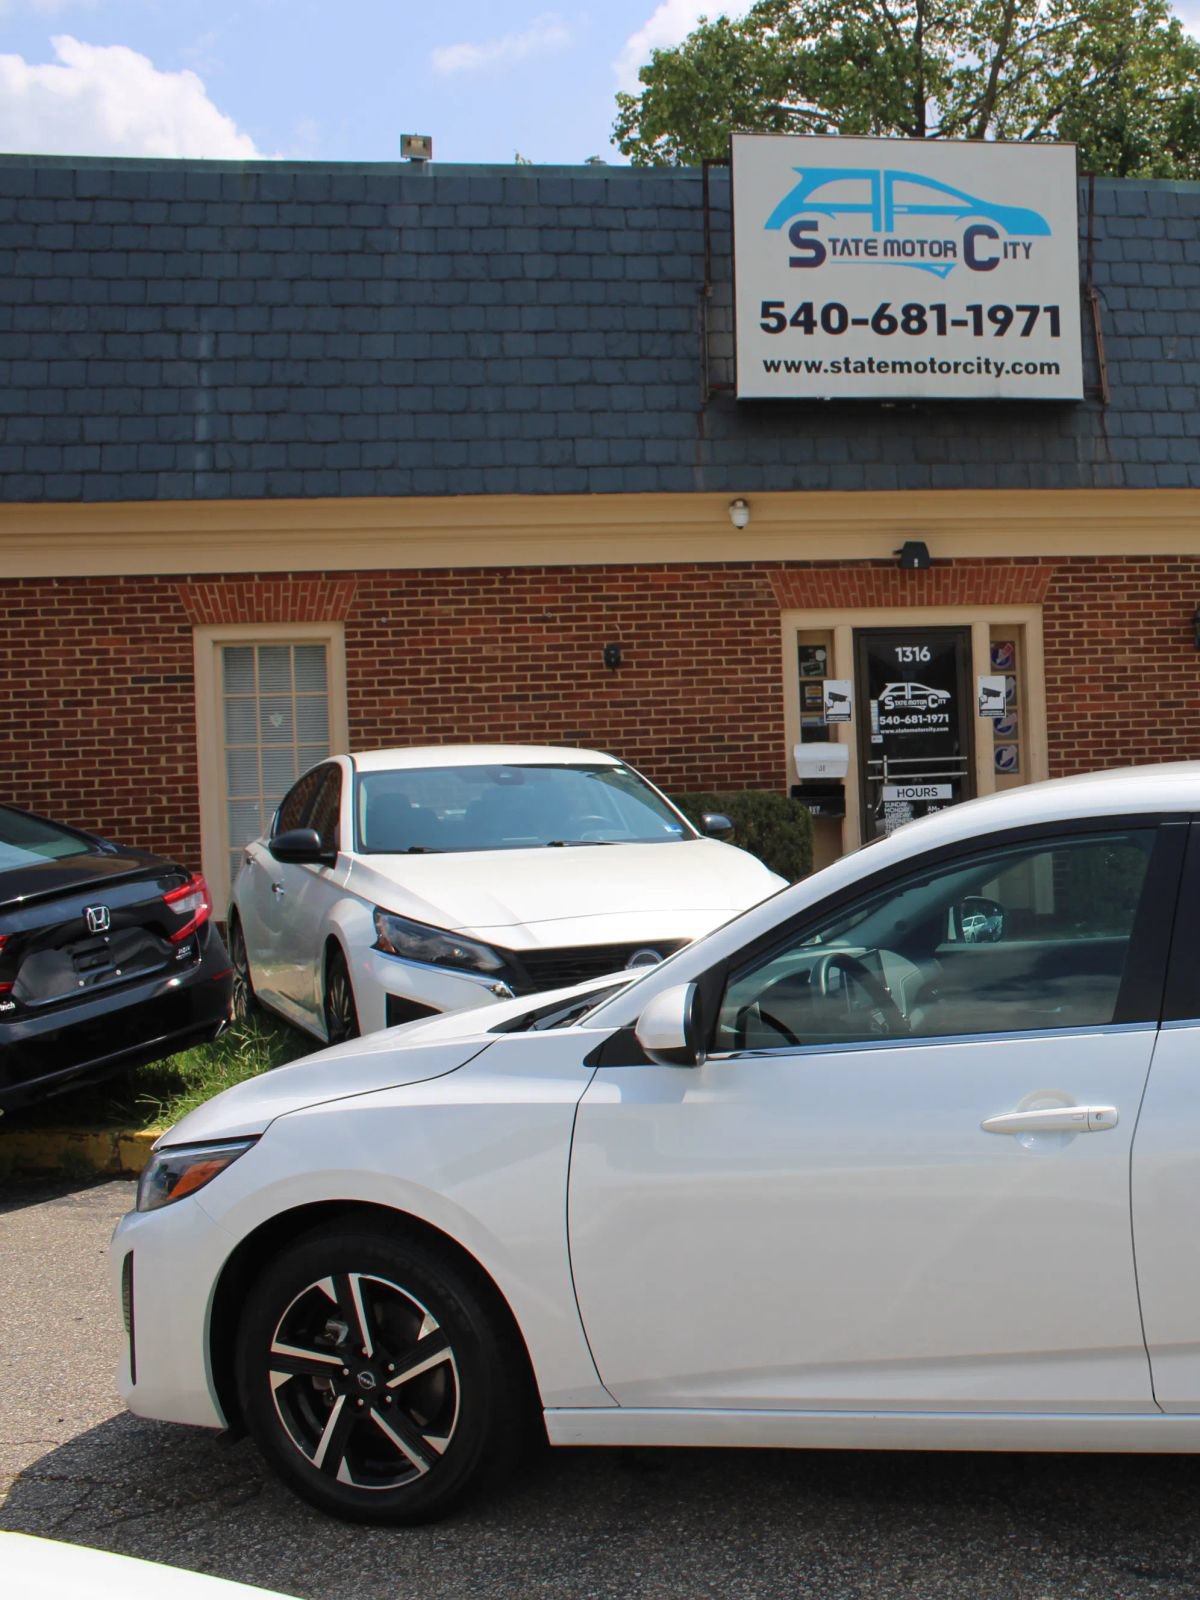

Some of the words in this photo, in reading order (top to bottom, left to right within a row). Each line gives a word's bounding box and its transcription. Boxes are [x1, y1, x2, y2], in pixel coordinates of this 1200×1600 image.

[788, 220, 878, 269] STATE
[883, 238, 957, 258] MOTOR
[963, 223, 1033, 272] CITY
[759, 300, 1061, 338] 540-681-1971
[762, 356, 1061, 378] www.statemotorcity.com
[895, 646, 931, 662] 1316
[879, 714, 949, 725] 540-681-1971
[896, 787, 938, 798] HOURS
